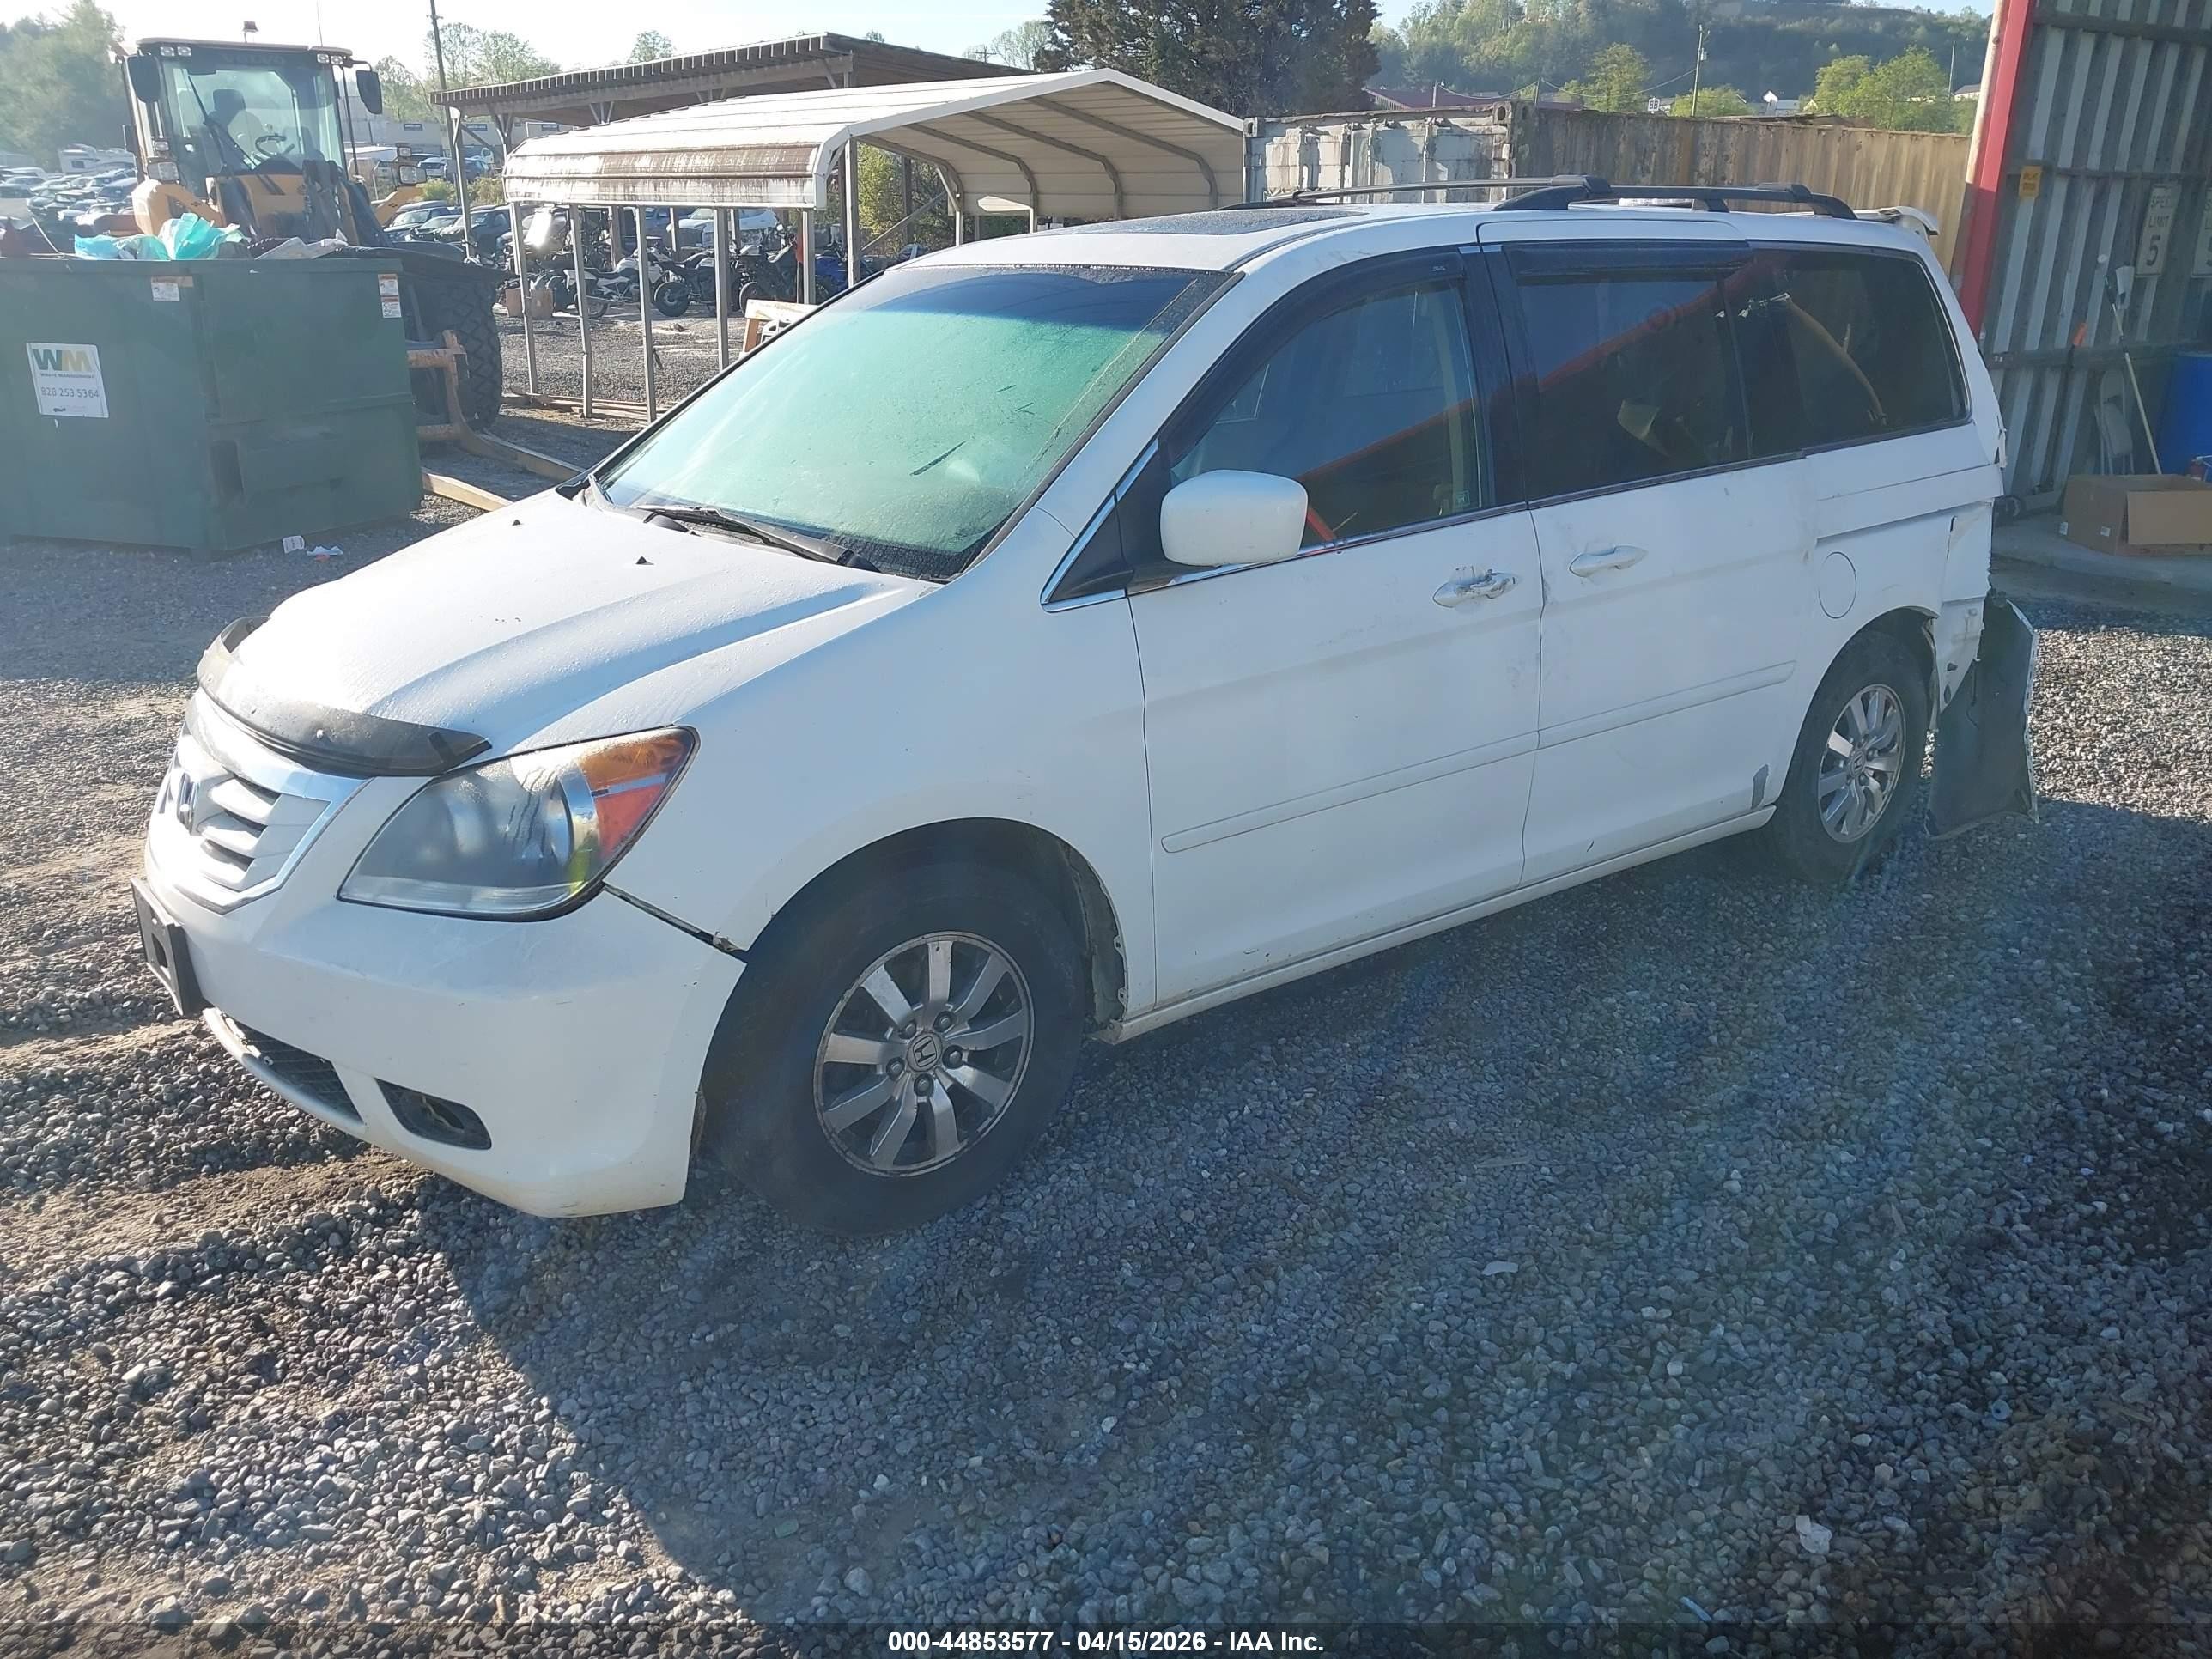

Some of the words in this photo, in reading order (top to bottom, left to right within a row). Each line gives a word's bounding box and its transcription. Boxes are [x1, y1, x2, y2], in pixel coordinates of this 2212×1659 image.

[2148, 215, 2170, 228] LIMIT
[2146, 234, 2160, 266] 5
[33, 349, 93, 371] WM
[58, 387, 75, 398] 253
[76, 388, 100, 398] 5364
